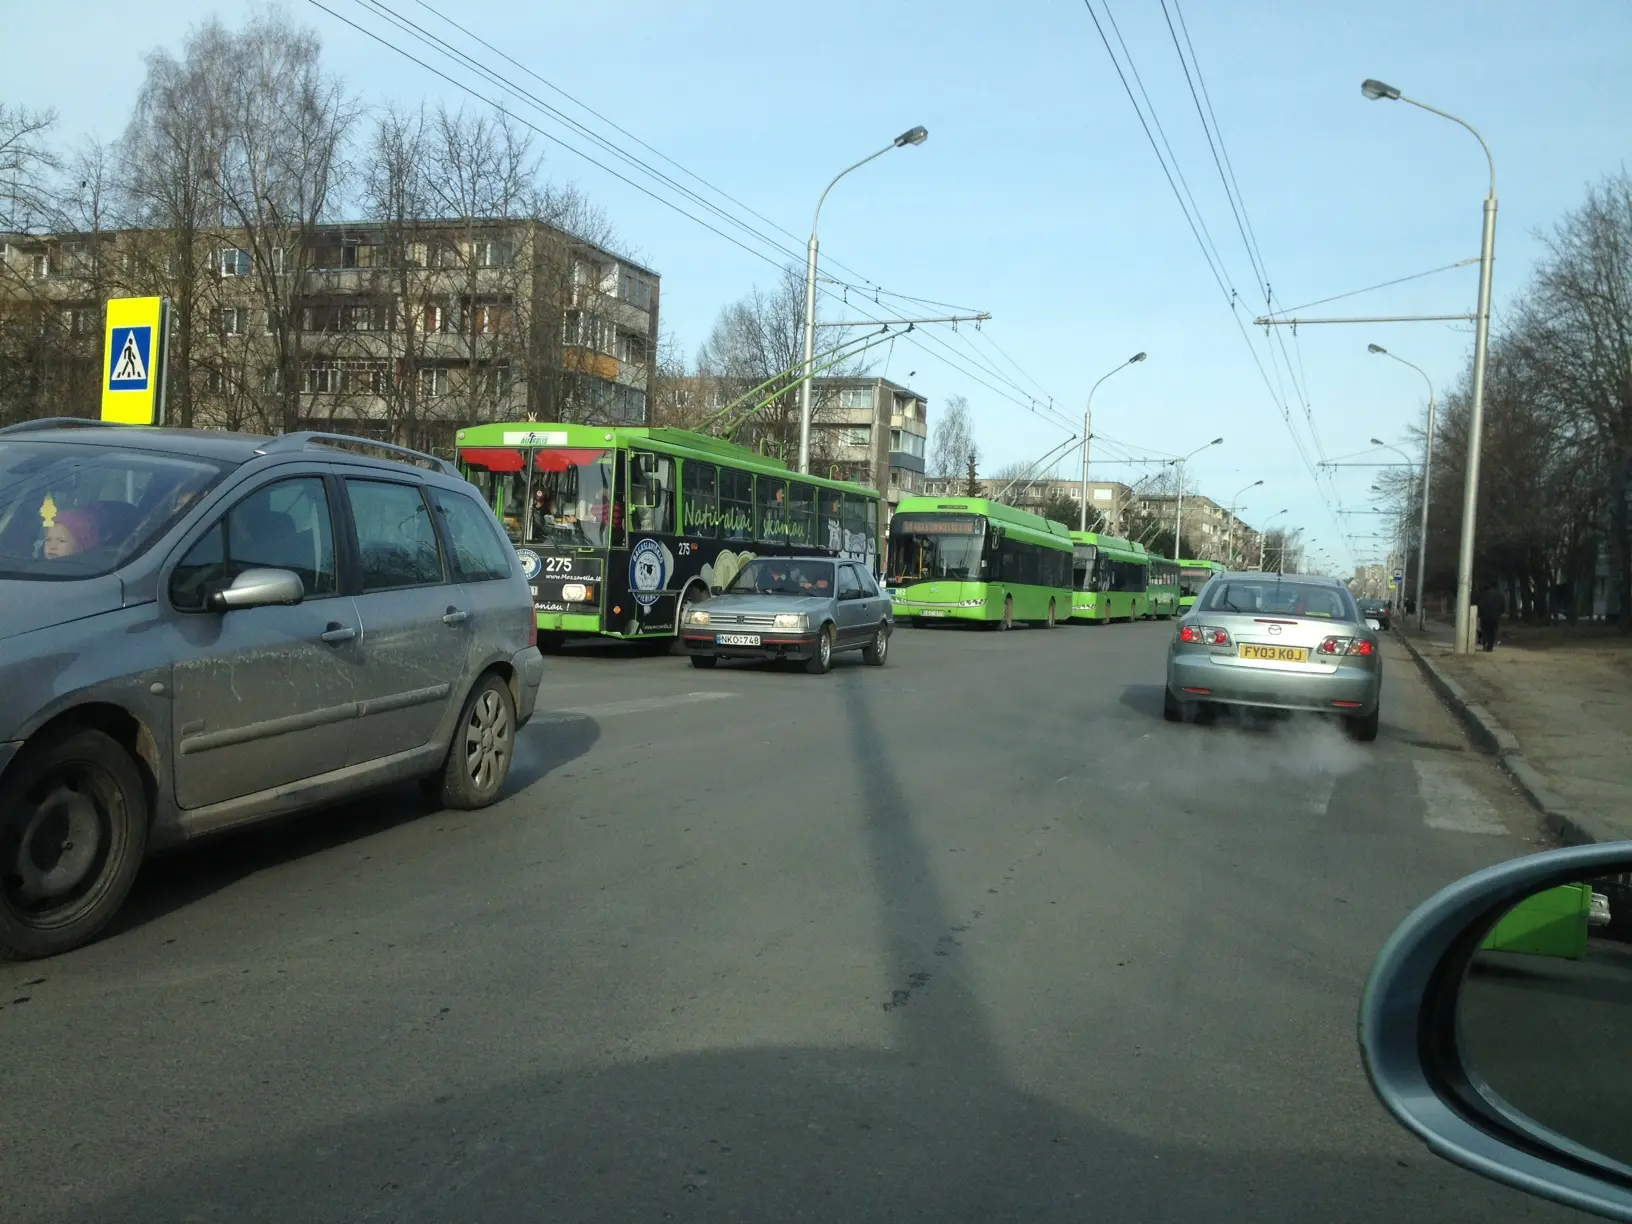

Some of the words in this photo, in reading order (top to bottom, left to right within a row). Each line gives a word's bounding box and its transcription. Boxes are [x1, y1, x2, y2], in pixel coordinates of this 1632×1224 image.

[678, 542, 690, 555] 275
[546, 557, 572, 572] 275
[534, 601, 563, 611] aniau
[1244, 646, 1276, 659] FY03
